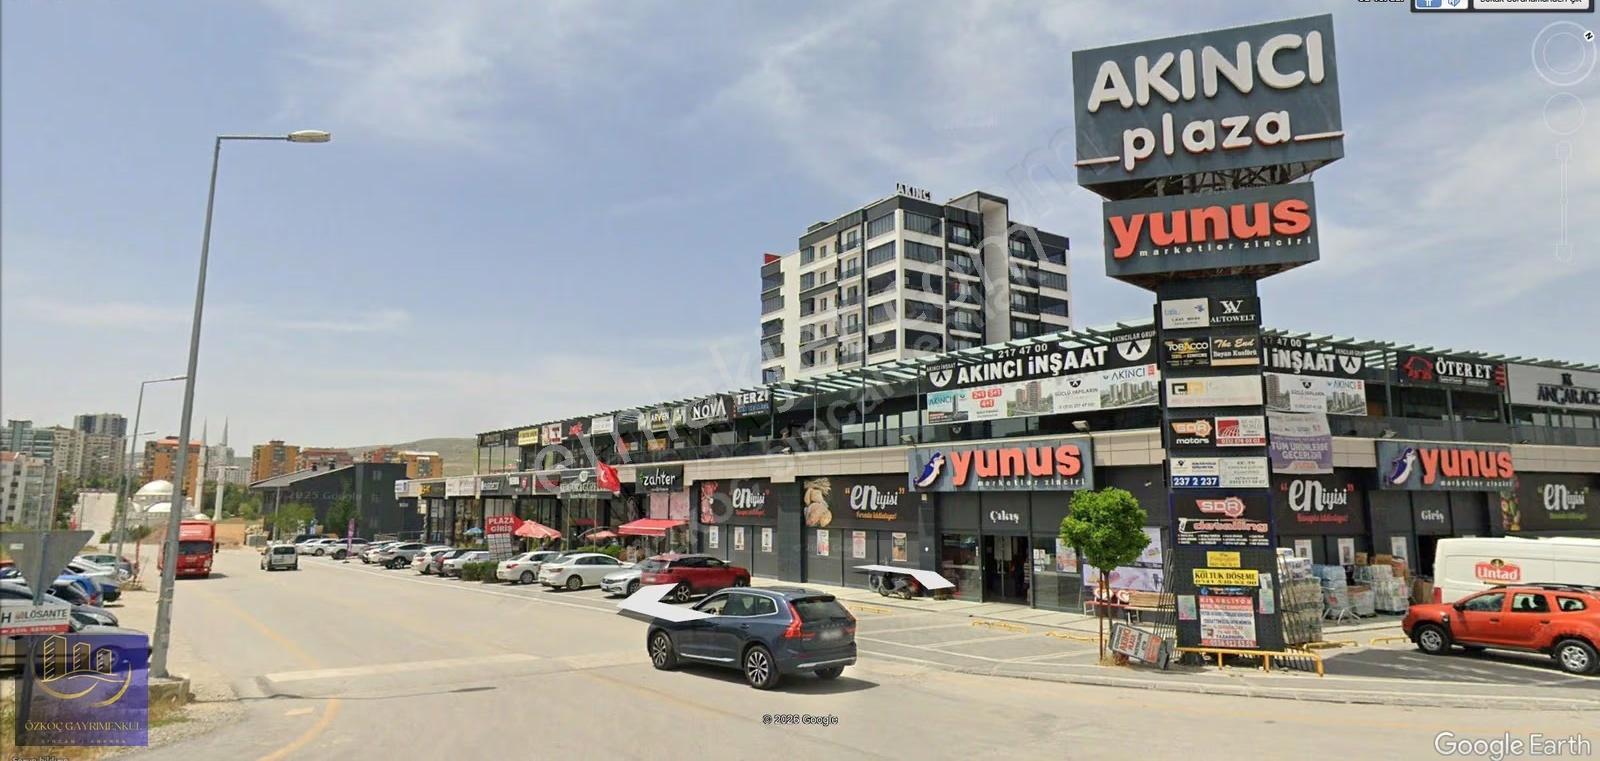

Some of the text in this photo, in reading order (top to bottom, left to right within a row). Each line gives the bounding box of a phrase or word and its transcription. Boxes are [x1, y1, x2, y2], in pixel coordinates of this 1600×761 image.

[1087, 30, 1325, 112] AKINCI
[1123, 110, 1291, 172] plaza
[1108, 199, 1311, 260] yunus
[1139, 236, 1313, 256] marketler zinciri
[1210, 314, 1256, 323] AUTOWELT
[1168, 341, 1209, 351] TOBACCO
[1214, 337, 1256, 349] The End
[1290, 338, 1302, 347] 00
[998, 343, 1048, 359] 217 47 00
[957, 360, 1022, 385] AKINCI
[1111, 367, 1145, 380] AKINCI
[1435, 356, 1492, 379] ÖTER ET
[693, 396, 727, 420] NOVA
[1176, 437, 1210, 445] motors
[950, 444, 1081, 486] yunus
[1419, 448, 1514, 484] yunus
[643, 468, 676, 486] zahter
[1173, 477, 1218, 486] 237 2 237
[1202, 501, 1239, 511] SDR
[488, 516, 515, 526] PLAZA
[989, 510, 1020, 524] Çıkış
[1421, 510, 1444, 523] Giriş
[1477, 565, 1518, 580] Untad
